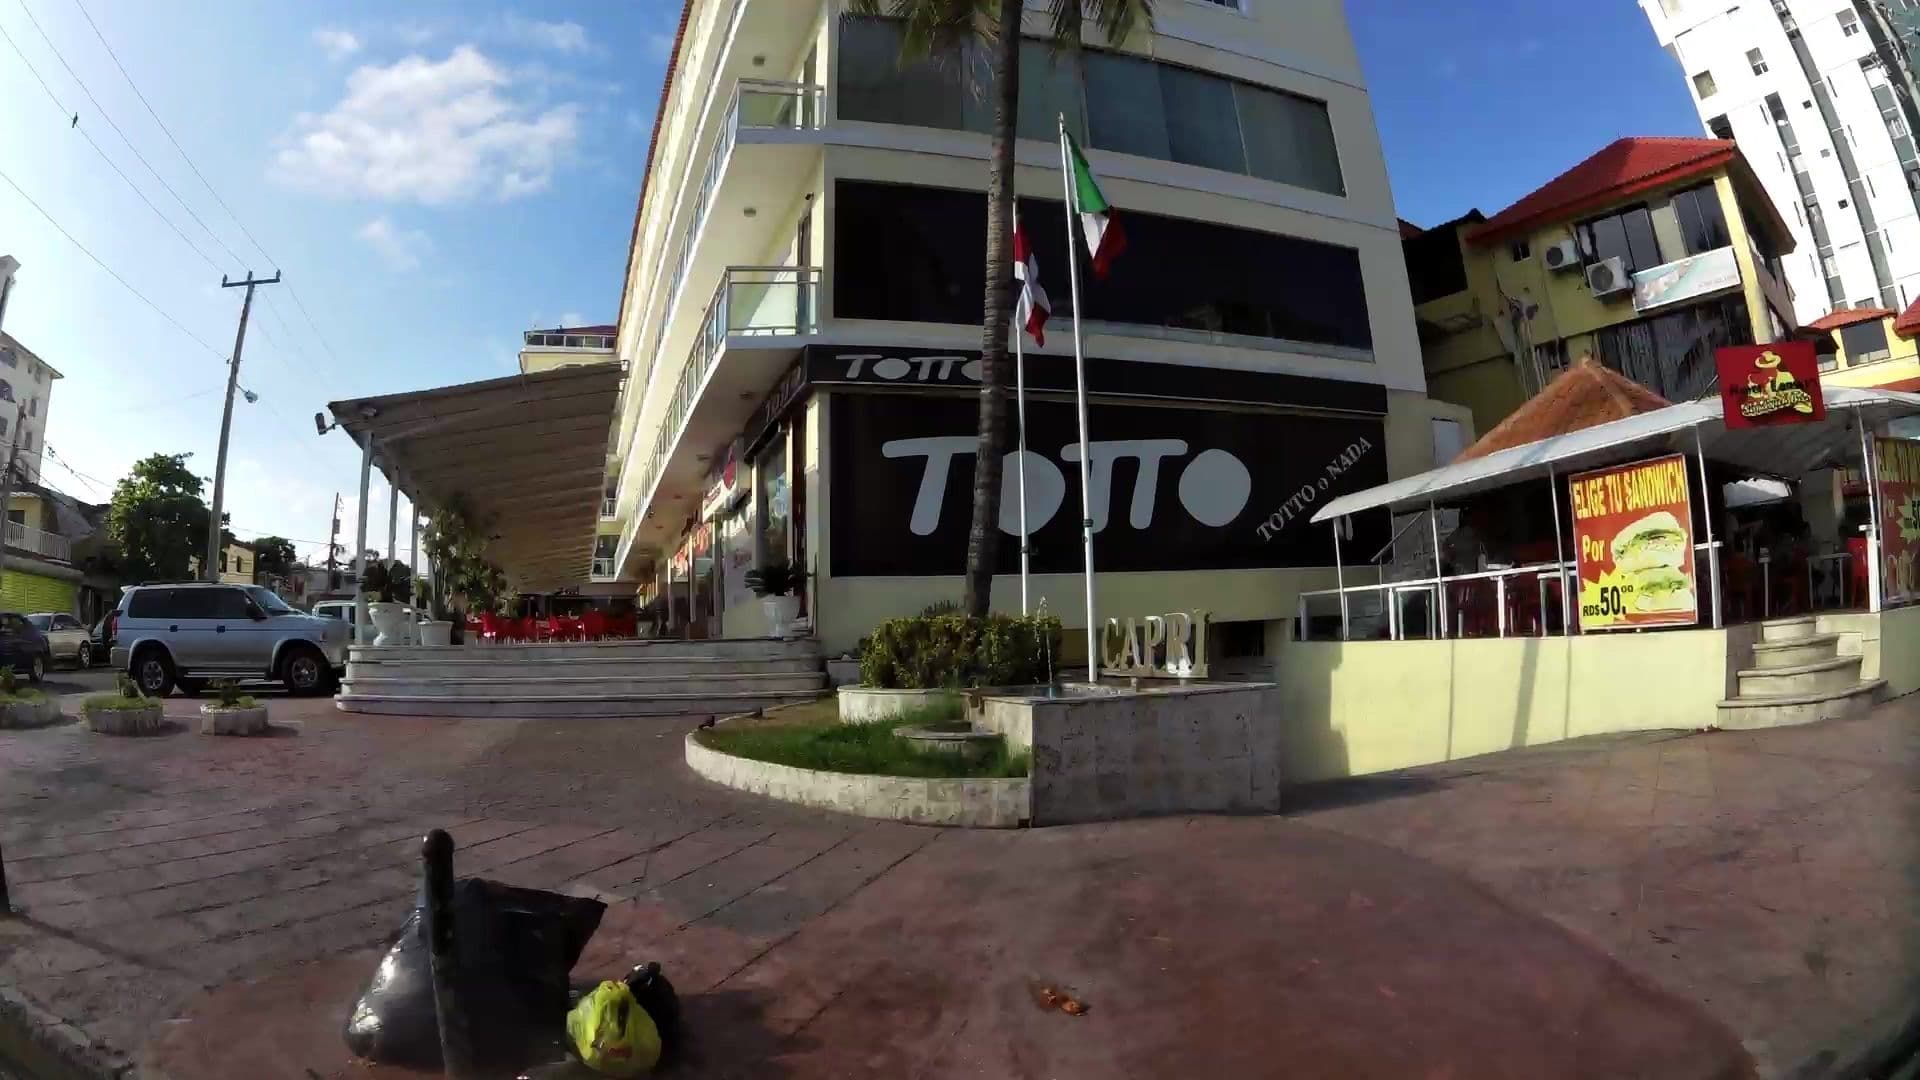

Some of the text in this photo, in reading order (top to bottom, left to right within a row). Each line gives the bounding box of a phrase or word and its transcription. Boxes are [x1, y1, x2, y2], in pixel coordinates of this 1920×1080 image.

[835, 354, 984, 382] TOTTO
[881, 436, 1252, 537] TOTTO
[1256, 485, 1316, 541] TOTTO
[1326, 436, 1373, 480] NADA
[1572, 462, 1687, 520] ELIGE TU SANDWICH
[1582, 534, 1606, 563] Por
[1101, 608, 1209, 678] CAPRI
